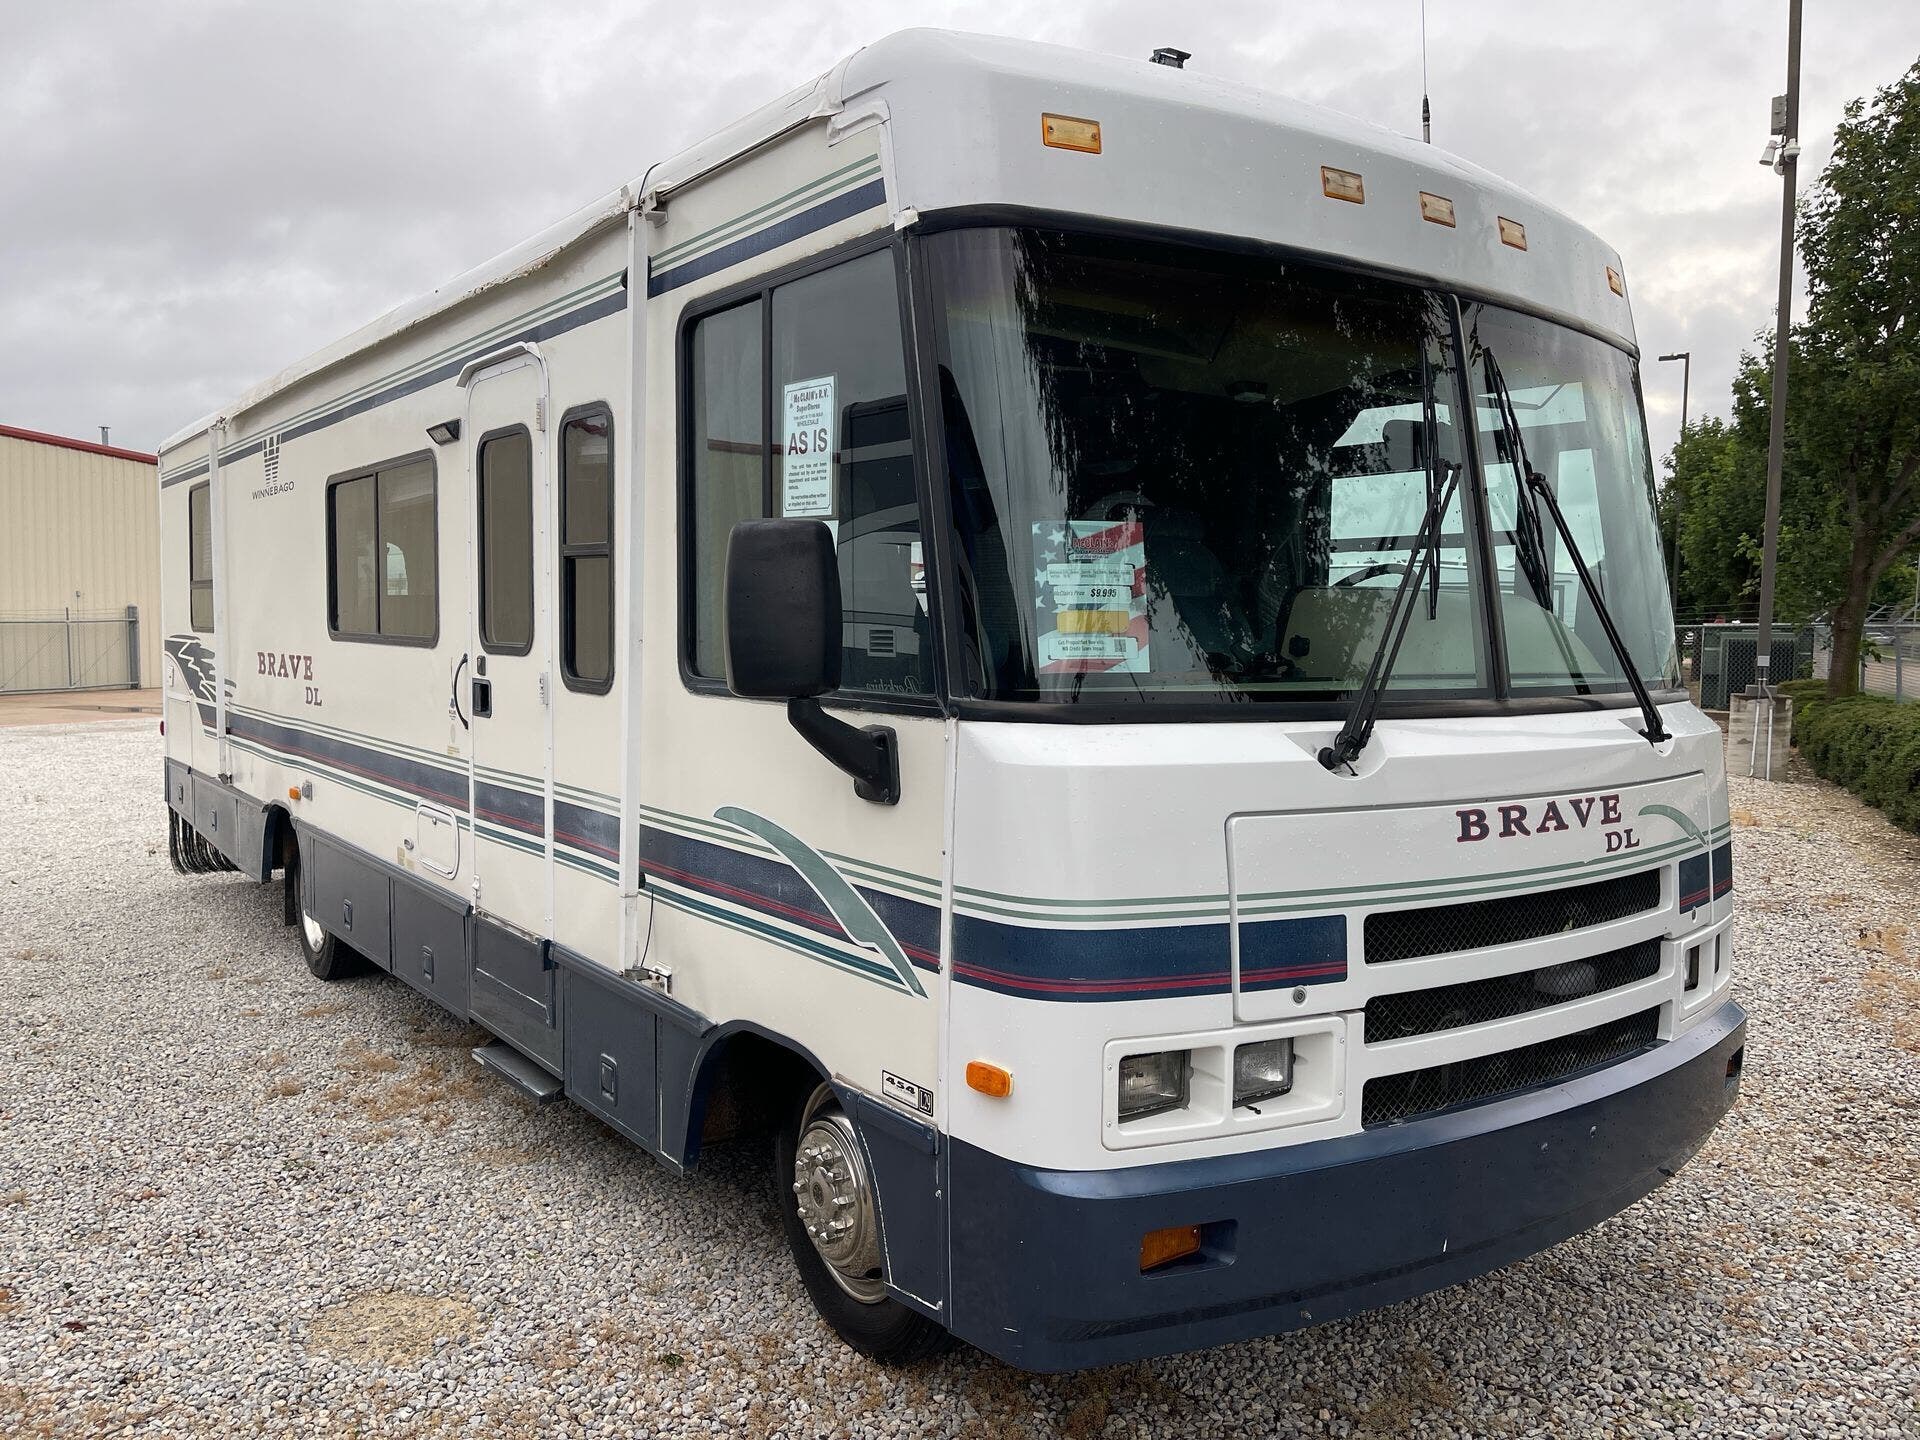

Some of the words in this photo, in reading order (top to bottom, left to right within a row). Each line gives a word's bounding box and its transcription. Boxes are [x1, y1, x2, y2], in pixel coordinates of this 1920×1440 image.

[788, 431, 808, 455] AS
[813, 428, 828, 452] IS
[252, 481, 295, 500] WINNEBAGO
[257, 652, 313, 681] BRAVE
[305, 686, 322, 706] DL
[1456, 794, 1622, 842] BRAVE
[1605, 828, 1640, 853] DL
[886, 1076, 915, 1095] 454
